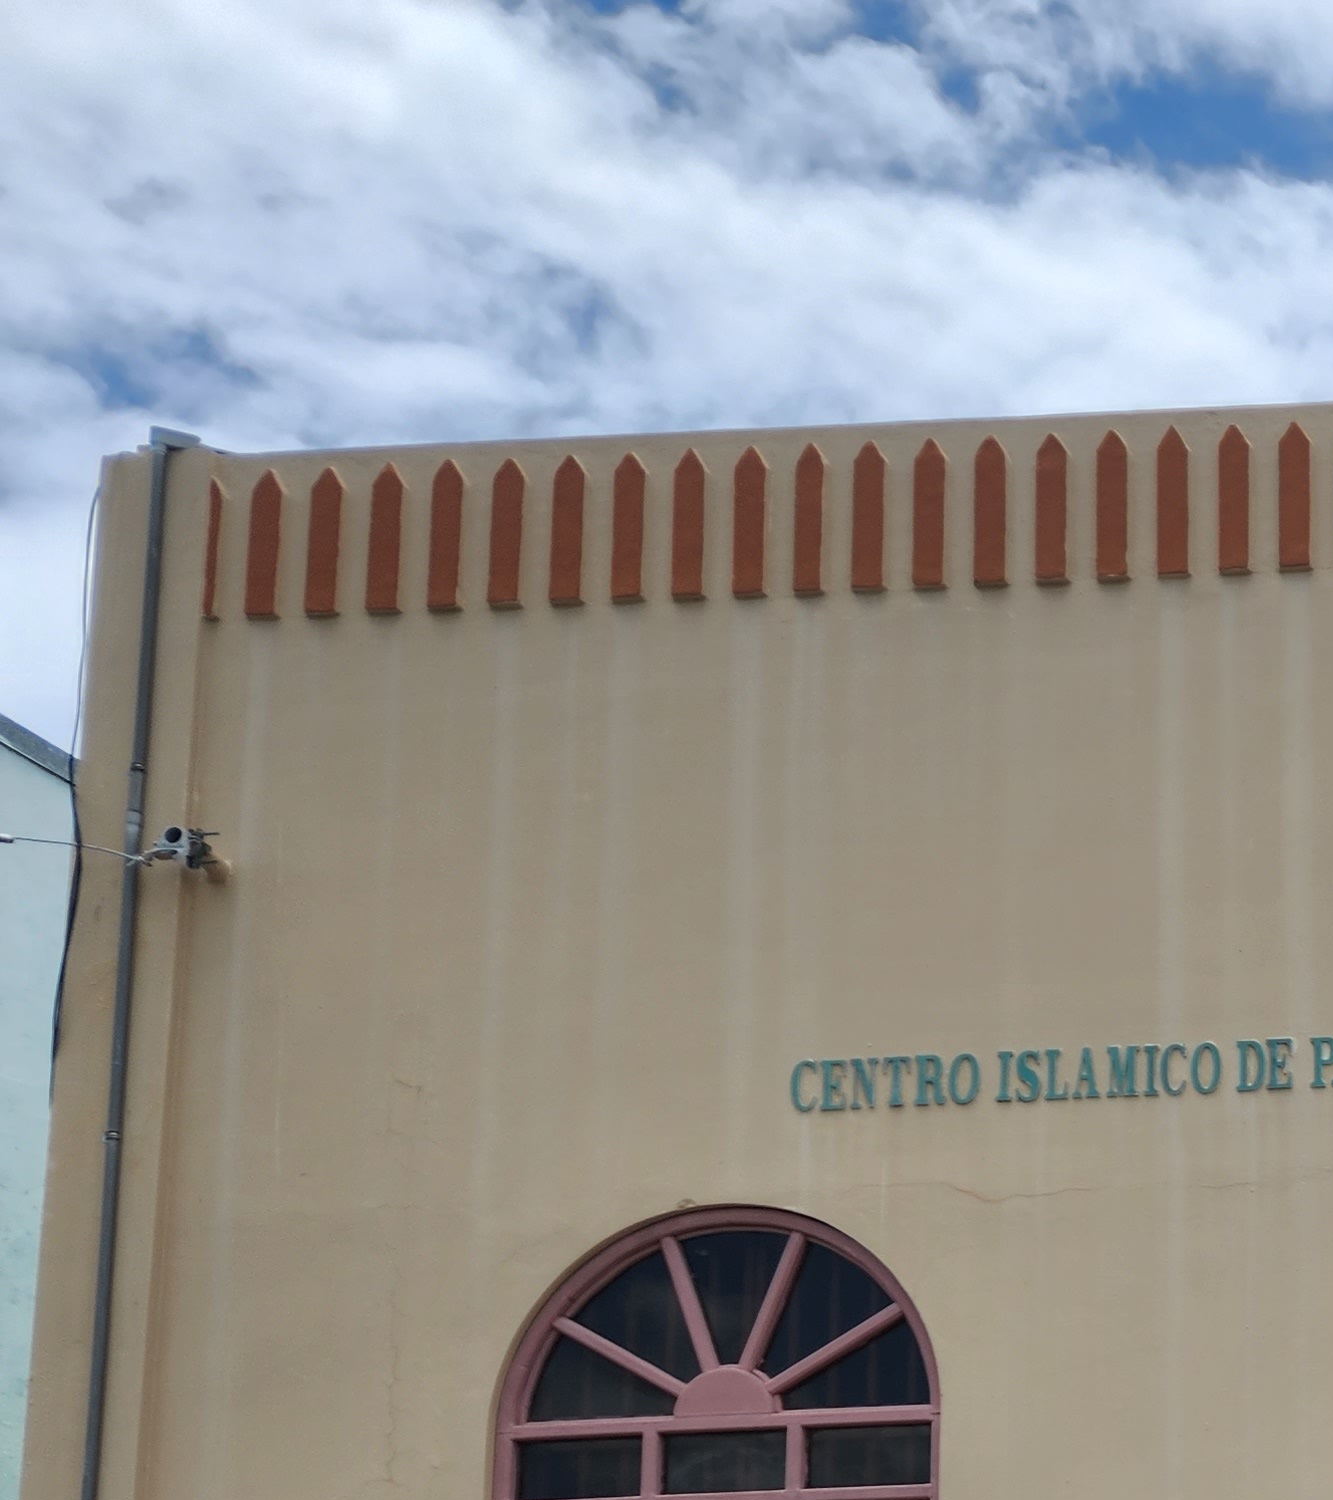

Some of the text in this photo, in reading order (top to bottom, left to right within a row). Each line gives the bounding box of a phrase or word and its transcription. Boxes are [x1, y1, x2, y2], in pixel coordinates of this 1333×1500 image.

[790, 1053, 981, 1113] CENTRO
[994, 1040, 1224, 1104] ISLAMICO
[1236, 1037, 1294, 1092] DE
